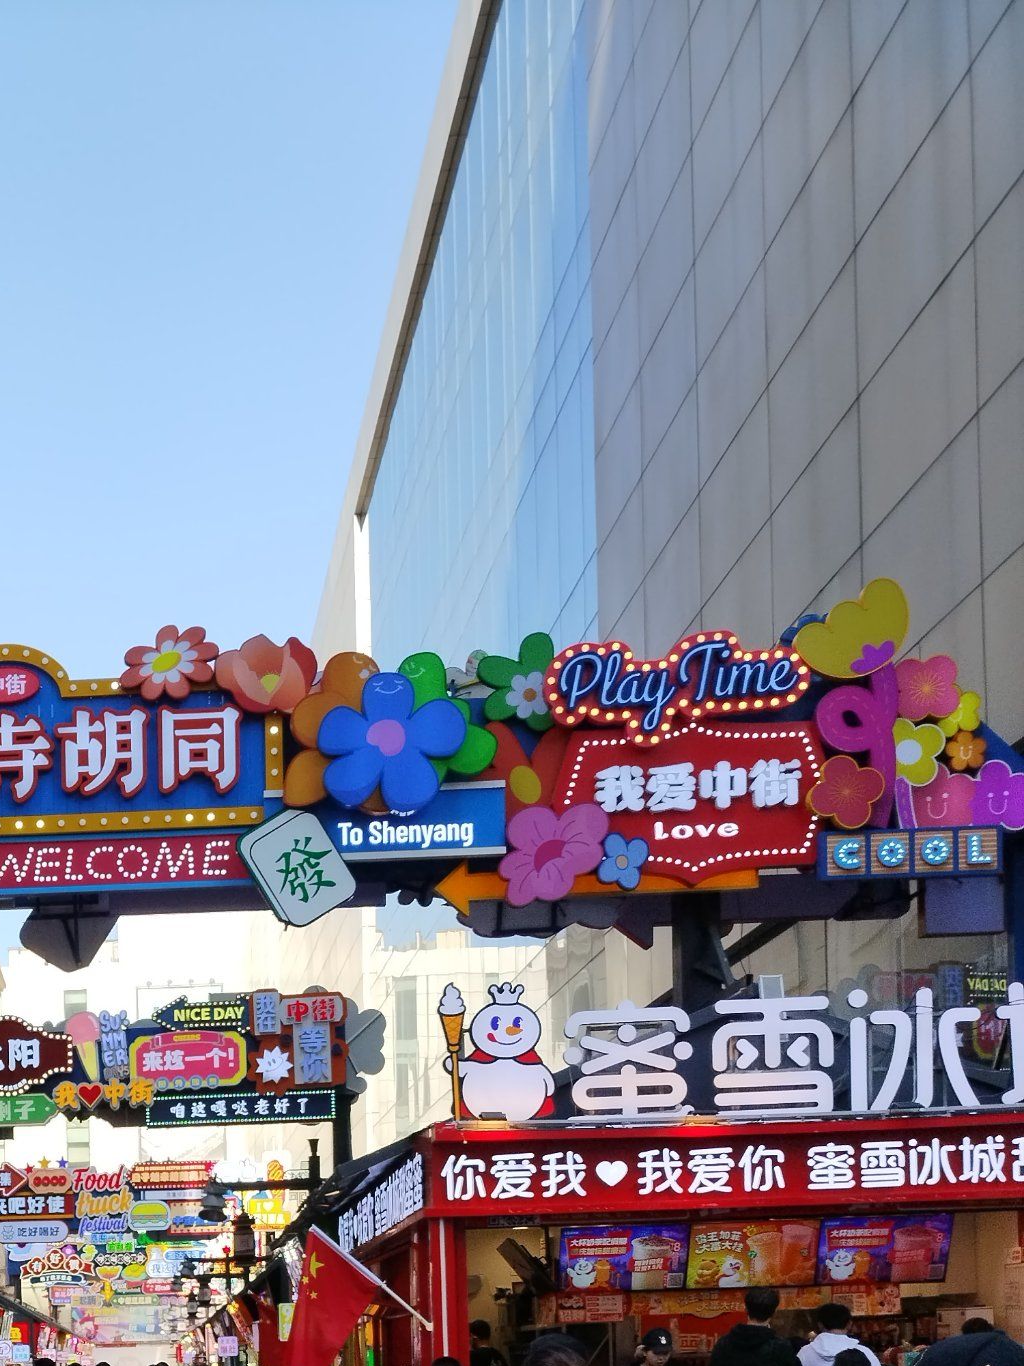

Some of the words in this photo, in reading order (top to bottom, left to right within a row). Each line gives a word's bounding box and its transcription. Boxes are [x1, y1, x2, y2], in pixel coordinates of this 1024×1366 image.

[560, 652, 675, 731] Play
[679, 641, 799, 704] Time
[594, 759, 803, 814] 我爱中街
[337, 822, 364, 847] To
[368, 820, 475, 850] Shenyang
[653, 820, 740, 841] Love
[833, 835, 994, 870] COOL
[275, 835, 338, 904] 發
[173, 1006, 212, 1022] NICE
[213, 1005, 245, 1021] DAY
[287, 997, 336, 1023] 中街
[54, 1081, 77, 1108] 我
[104, 1080, 154, 1107] 中街
[72, 1164, 125, 1192] Food
[441, 1152, 588, 1203] 你爱我
[636, 1146, 786, 1196] 我爱你
[76, 1188, 133, 1219] truck
[79, 1216, 127, 1237] festival
